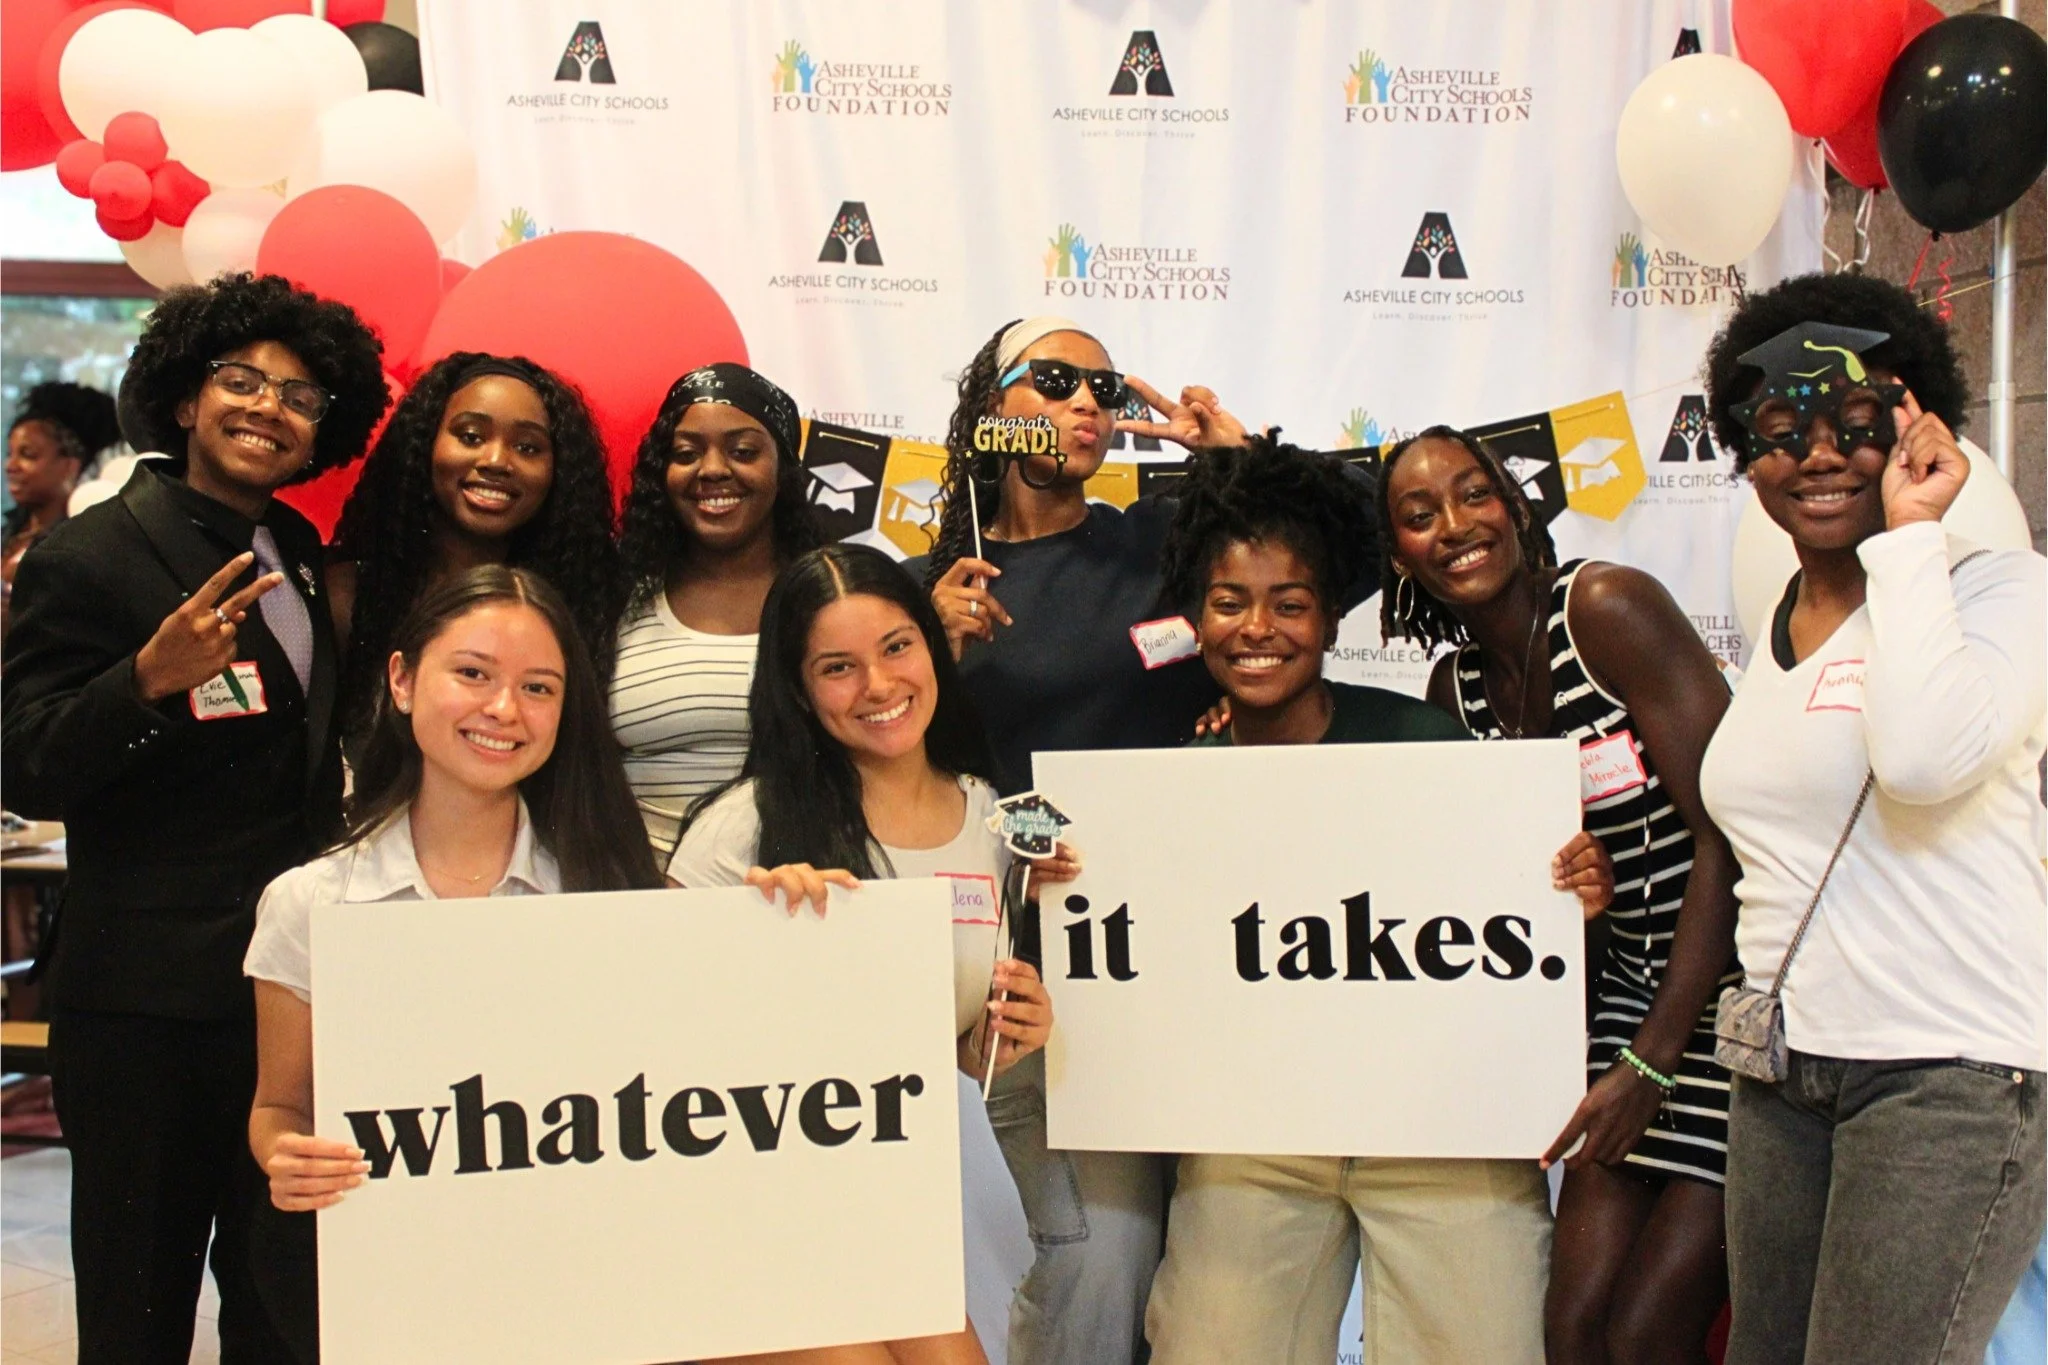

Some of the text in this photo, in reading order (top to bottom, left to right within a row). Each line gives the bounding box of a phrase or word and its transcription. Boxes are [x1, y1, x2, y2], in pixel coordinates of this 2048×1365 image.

[817, 60, 920, 79] ASHEVILLE
[1393, 66, 1500, 86] ASHEVILLE
[815, 78, 952, 98] CITY SCHOOLS
[1391, 84, 1532, 105] CITY SCHOOLS
[507, 93, 669, 110] ASHEVILLE CITY SCHOOLS
[773, 96, 950, 116] FOUNDATION
[1053, 108, 1229, 122] ASHEVILLE CITY SCHOOLS
[1345, 104, 1531, 123] FOUNDATION
[1093, 244, 1198, 262] ASHEVILLE
[1090, 261, 1231, 282] CITY SCHOOLS
[1648, 267, 1697, 286] CITY
[768, 275, 938, 293] ASHEVILLE CITY SCHOOLS
[1044, 280, 1229, 300] FOUNDATION
[1343, 289, 1525, 305] ASHEVILLE CITY SCHOOLS
[978, 414, 1053, 438] congrats
[974, 424, 1057, 455] GRAD!
[1333, 648, 1405, 662] ASHEVILLE
[1015, 805, 1050, 822] made
[1004, 814, 1061, 842] the grade
[952, 885, 983, 907] lena
[1064, 891, 1567, 982] it takes.
[343, 1071, 925, 1180] whatever
